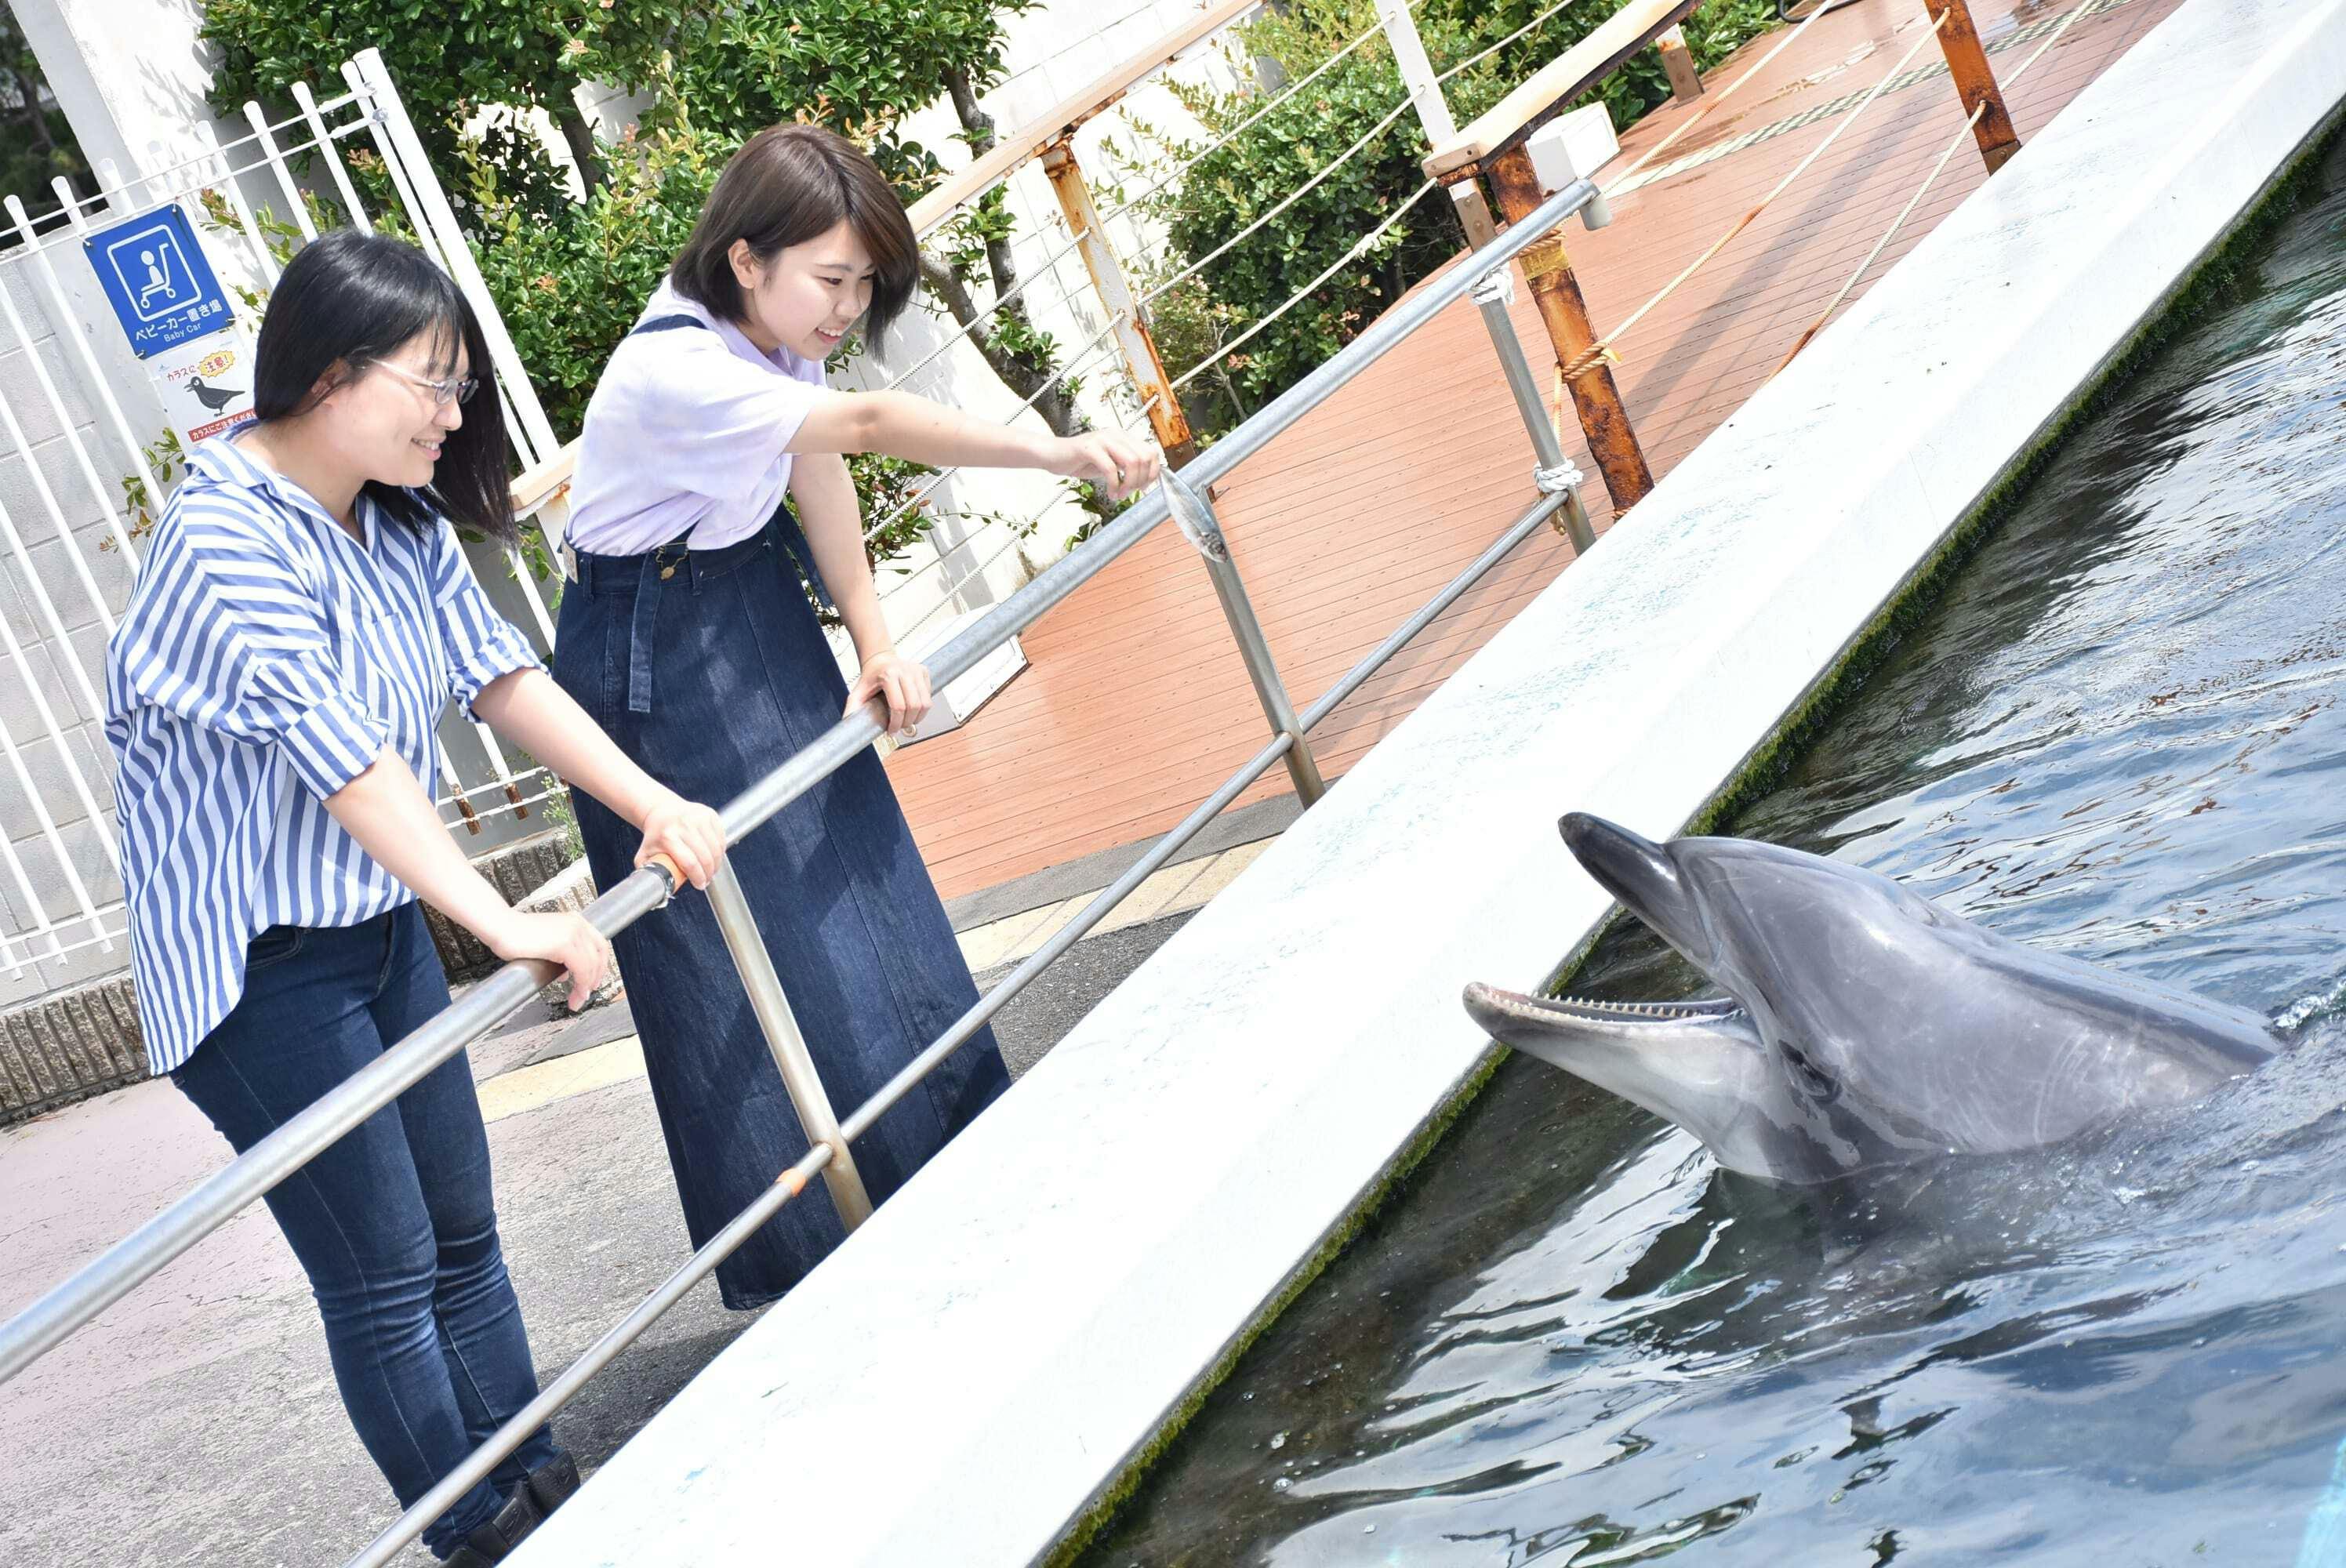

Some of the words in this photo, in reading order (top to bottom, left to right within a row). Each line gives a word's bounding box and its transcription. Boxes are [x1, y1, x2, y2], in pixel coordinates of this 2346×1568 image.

[136, 299, 223, 341] ベビーカー置き場
[163, 329, 185, 343] Baby
[186, 323, 202, 333] Car
